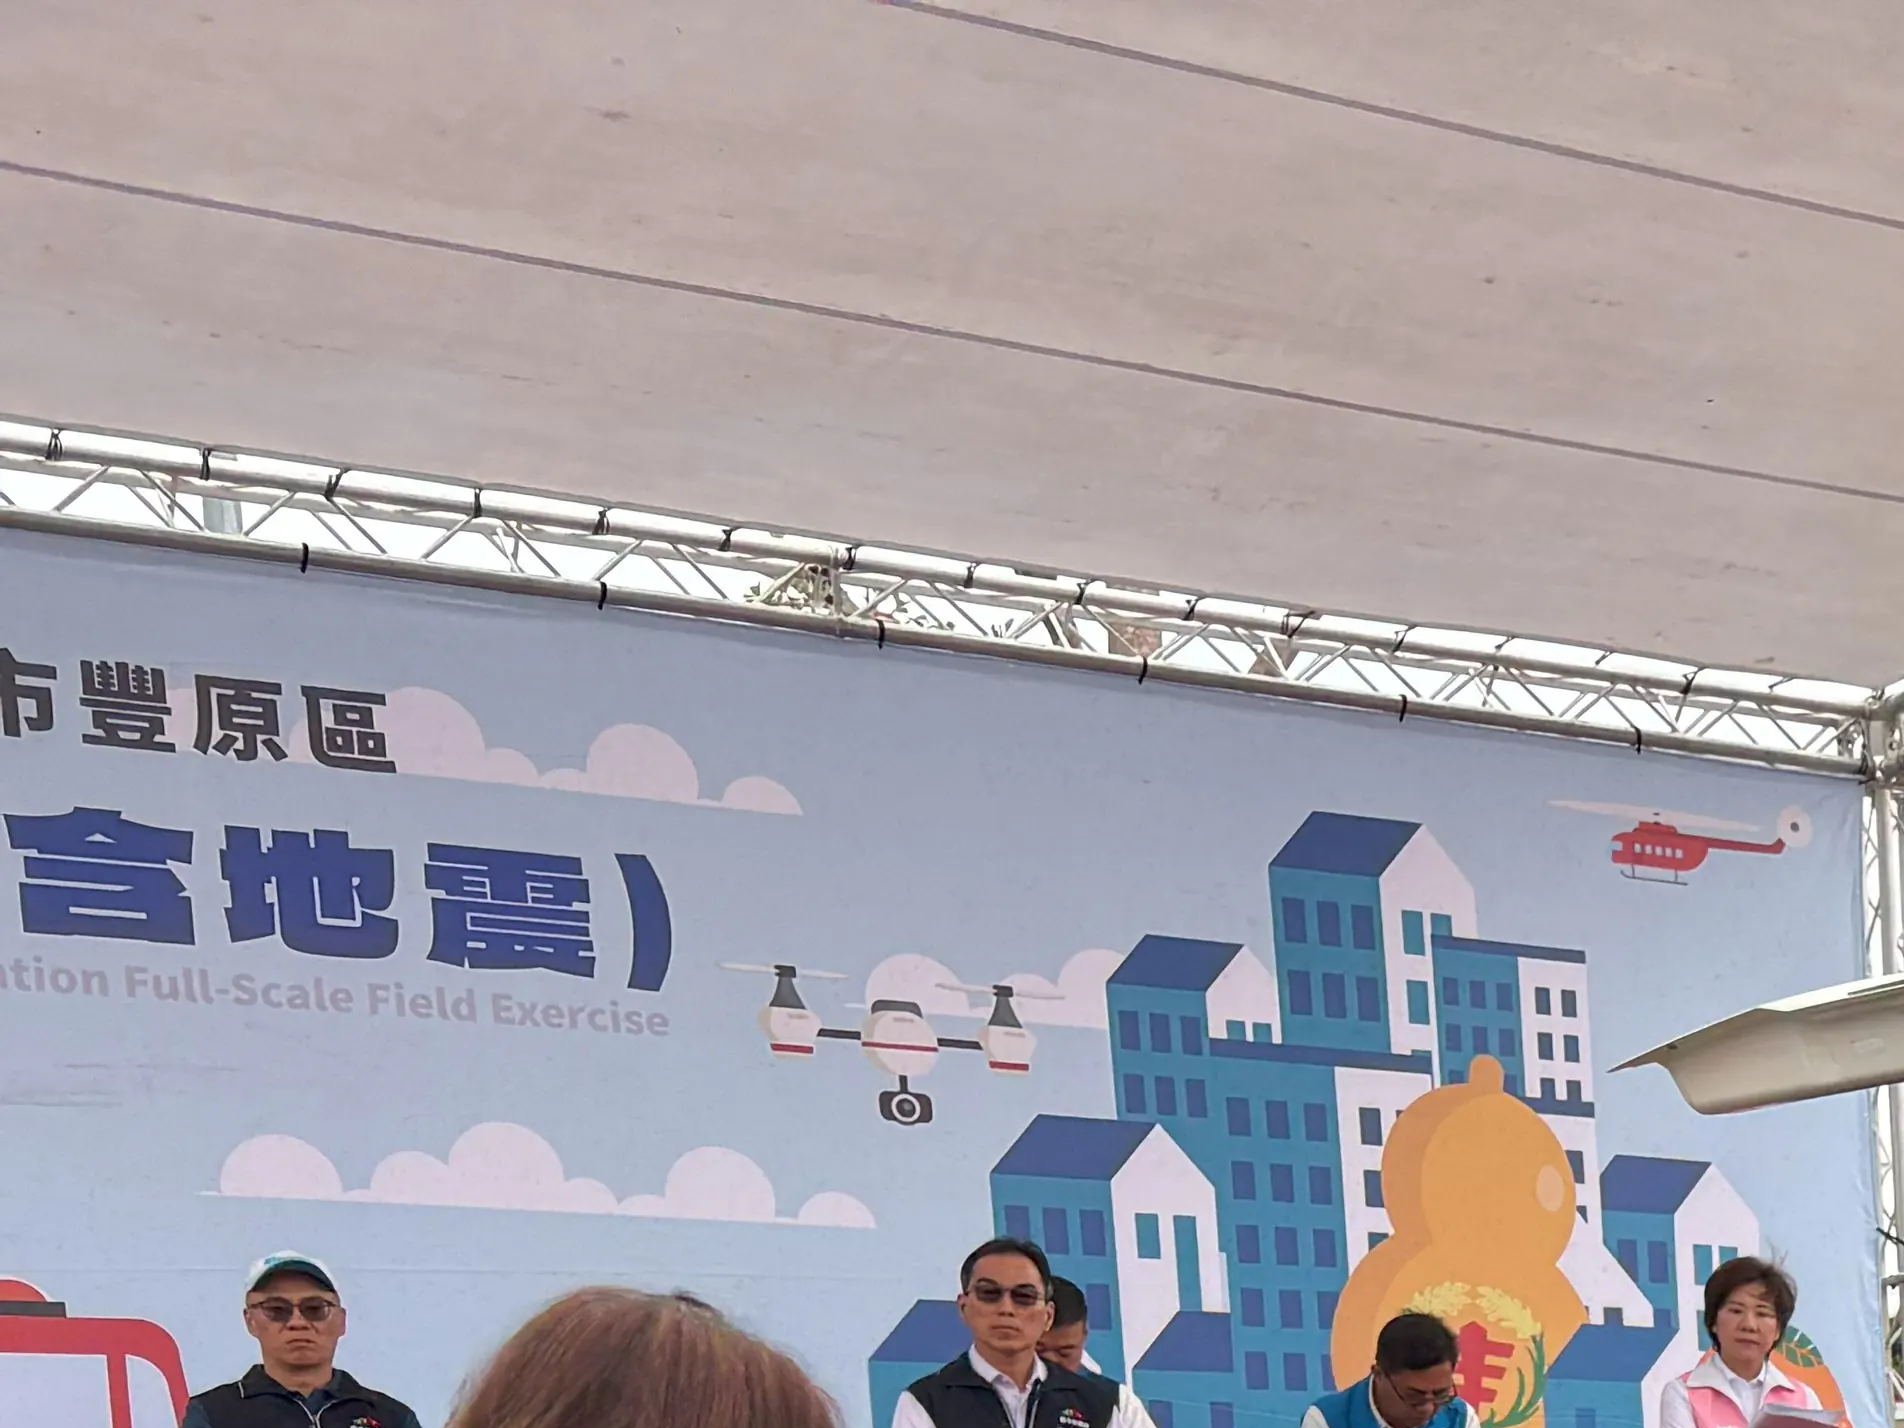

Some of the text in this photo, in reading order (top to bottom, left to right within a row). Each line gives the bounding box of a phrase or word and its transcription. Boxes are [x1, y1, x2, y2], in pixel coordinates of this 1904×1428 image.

[0, 956, 671, 1037] tion Full-Scale Field Exercise
